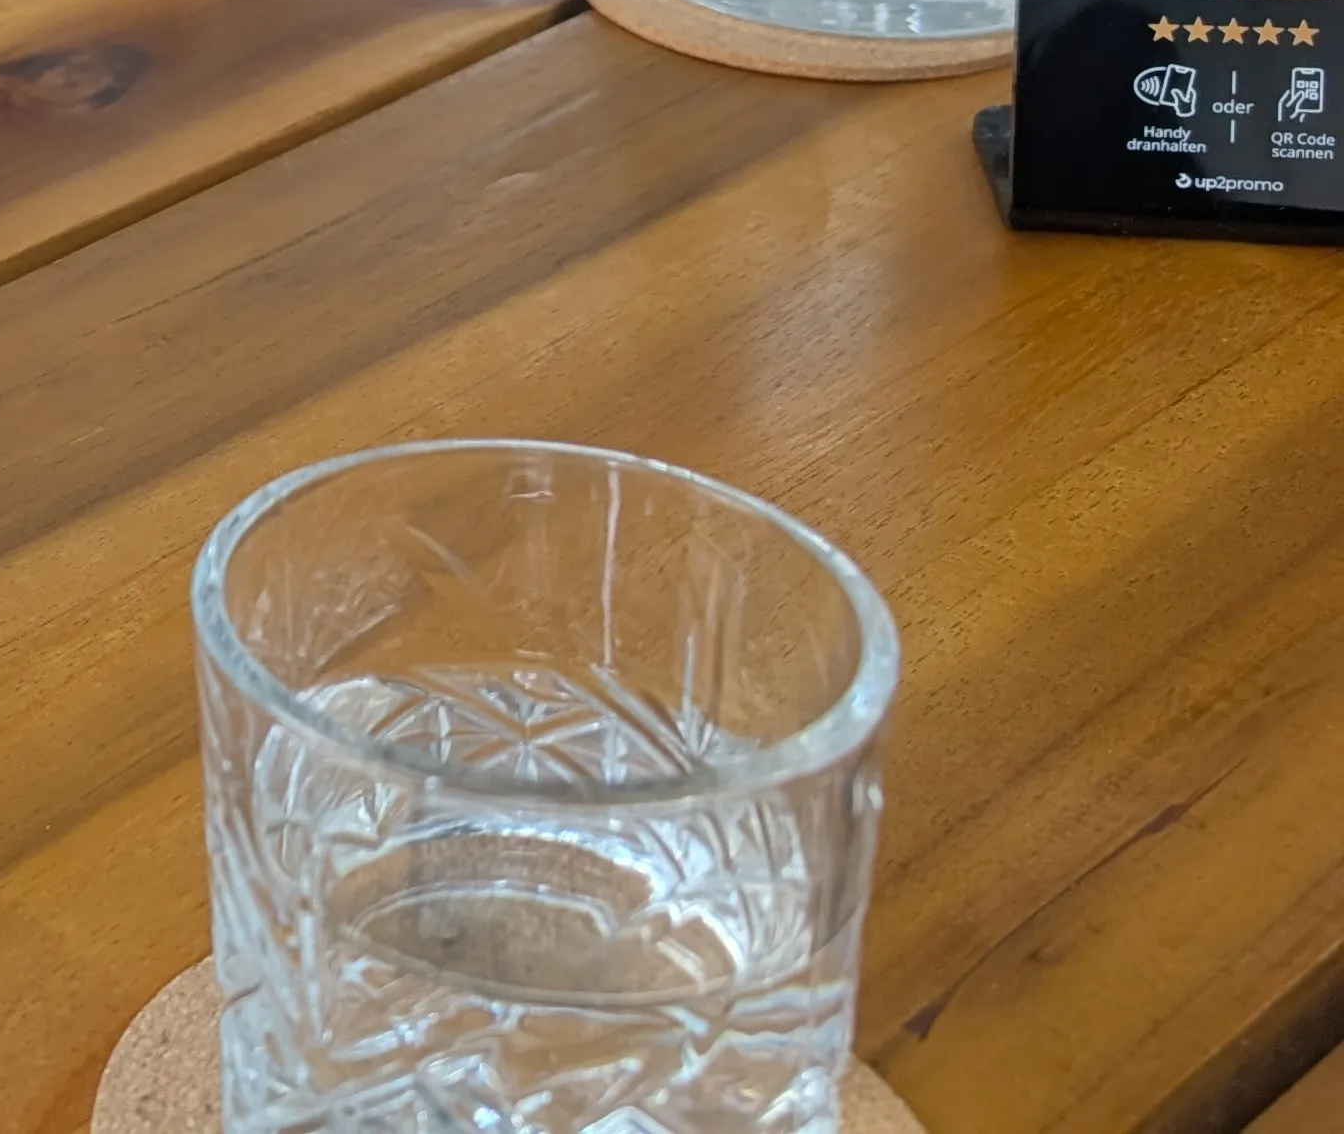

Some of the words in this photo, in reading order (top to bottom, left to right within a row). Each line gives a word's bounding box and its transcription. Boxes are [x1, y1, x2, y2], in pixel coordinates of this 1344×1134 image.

[1212, 99, 1255, 115] oder
[1143, 125, 1192, 142] Handy
[1270, 131, 1294, 146] QR
[1296, 132, 1336, 147] Code
[1126, 138, 1207, 154] dranhalten
[1271, 146, 1334, 160] scannen
[1194, 175, 1285, 193] up2promo
